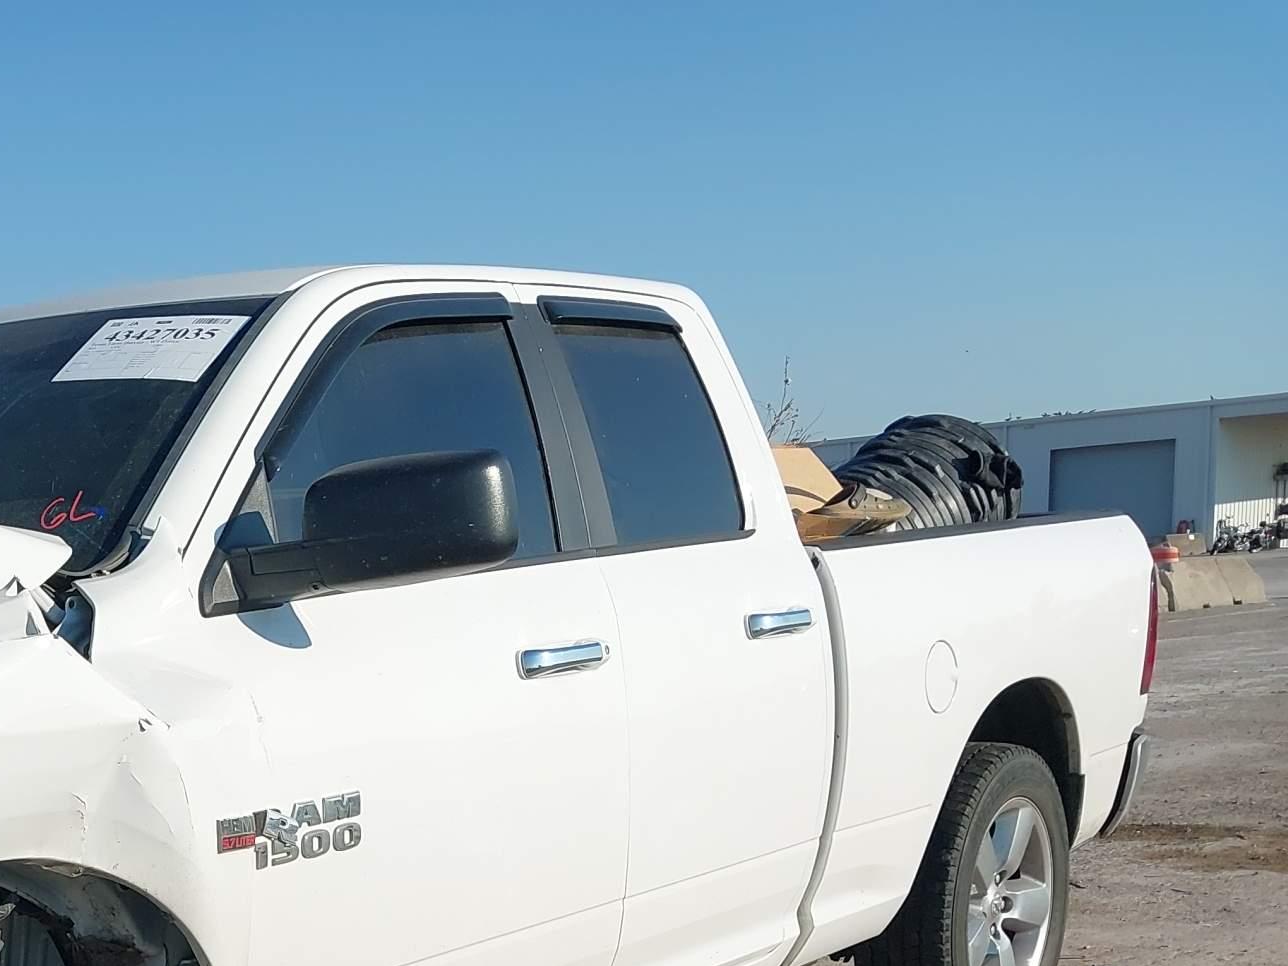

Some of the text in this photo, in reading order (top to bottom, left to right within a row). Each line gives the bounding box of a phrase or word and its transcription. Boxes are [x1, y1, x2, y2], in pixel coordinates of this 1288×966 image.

[104, 327, 221, 342] 43427035
[263, 790, 361, 846] RAM
[254, 822, 361, 870] 1500
